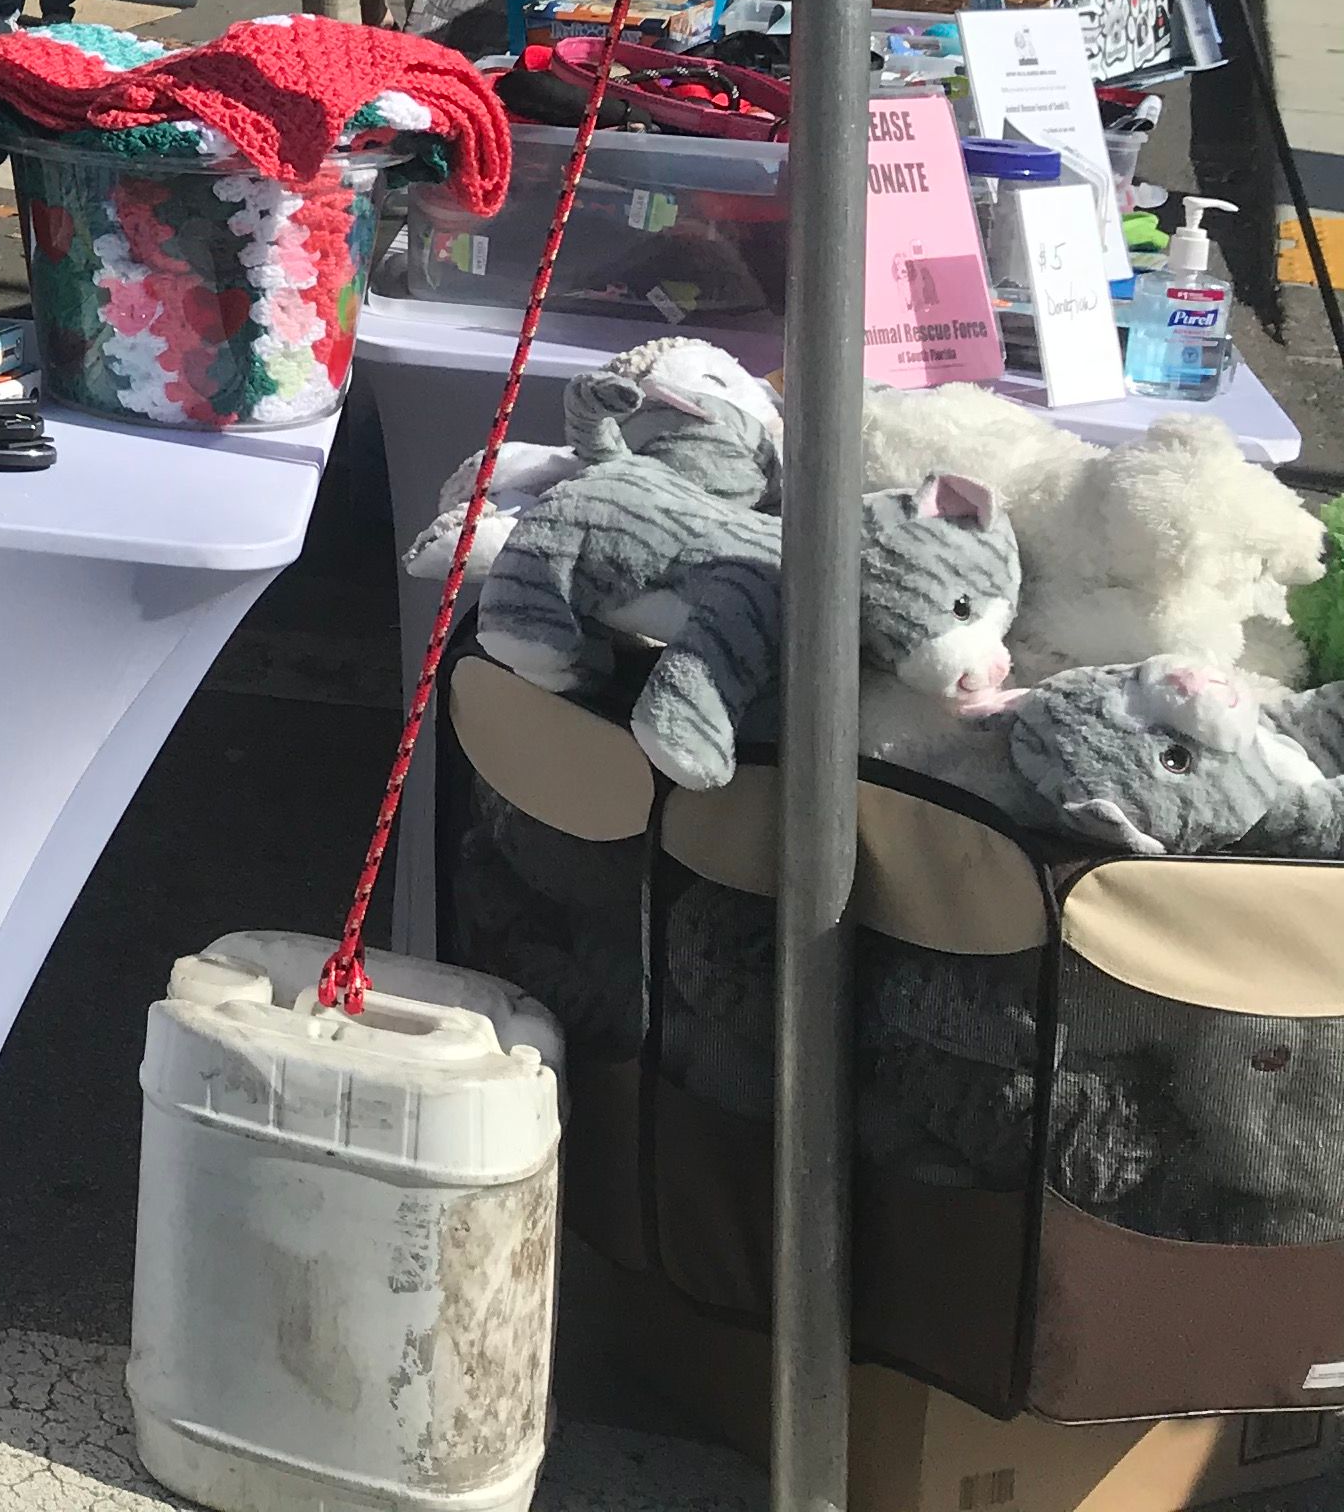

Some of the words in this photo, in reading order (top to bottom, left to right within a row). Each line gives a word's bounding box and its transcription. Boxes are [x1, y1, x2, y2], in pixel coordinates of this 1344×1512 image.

[868, 111, 915, 143] EASE
[867, 163, 930, 195] ONATE
[1174, 310, 1215, 326] Purell
[865, 324, 902, 345] nimal
[904, 322, 952, 342] Rescue
[953, 319, 988, 340] Force
[897, 352, 905, 363] of
[907, 349, 929, 364] South
[930, 348, 957, 362] Florida
